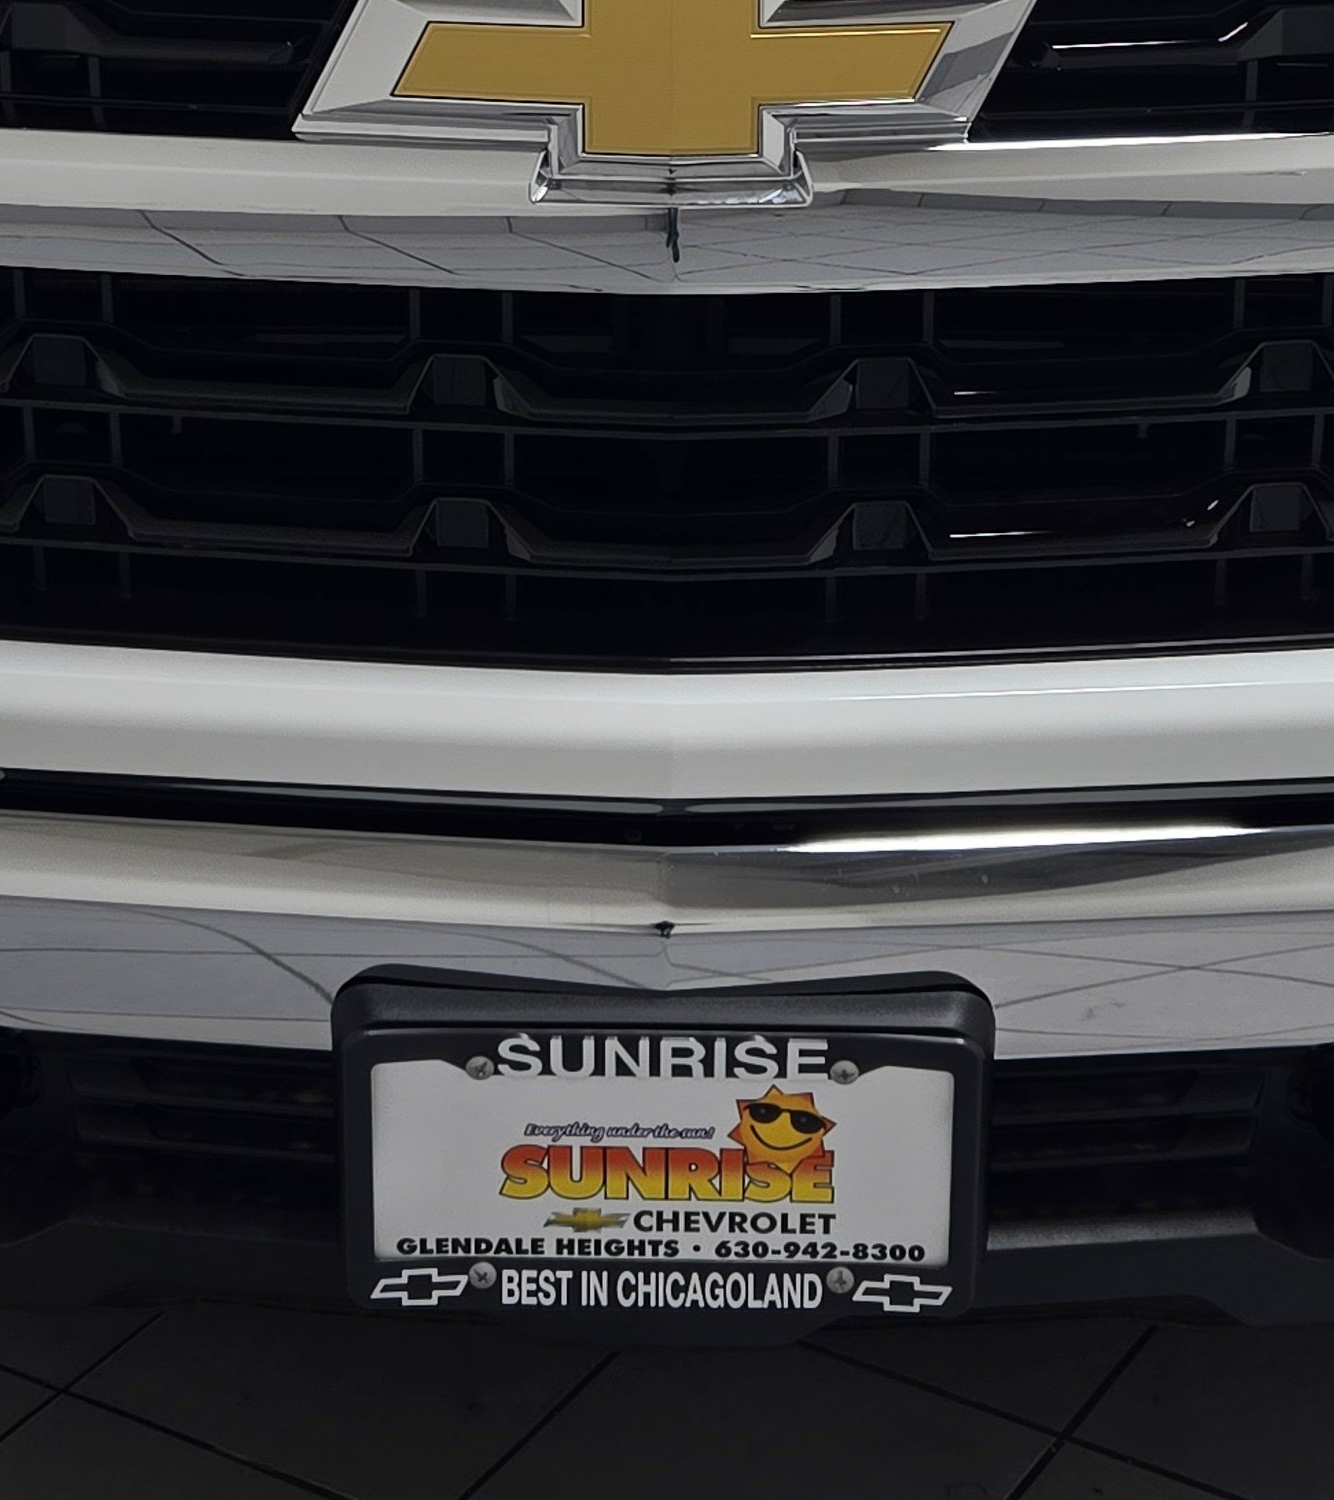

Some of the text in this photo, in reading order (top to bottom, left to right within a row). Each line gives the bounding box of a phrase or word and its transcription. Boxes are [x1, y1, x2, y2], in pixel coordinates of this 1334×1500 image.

[497, 1035, 830, 1080] SUNRISE
[524, 1121, 605, 1142] Everything
[606, 1123, 653, 1138] under
[653, 1124, 680, 1138] the
[499, 1144, 835, 1204] SUNRISE
[633, 1209, 836, 1235] CHEVROLET
[396, 1237, 926, 1262] GLENDALE HEIGHTS 630-942-8300
[501, 1270, 823, 1309] BEST IN CHICAGOLAND
